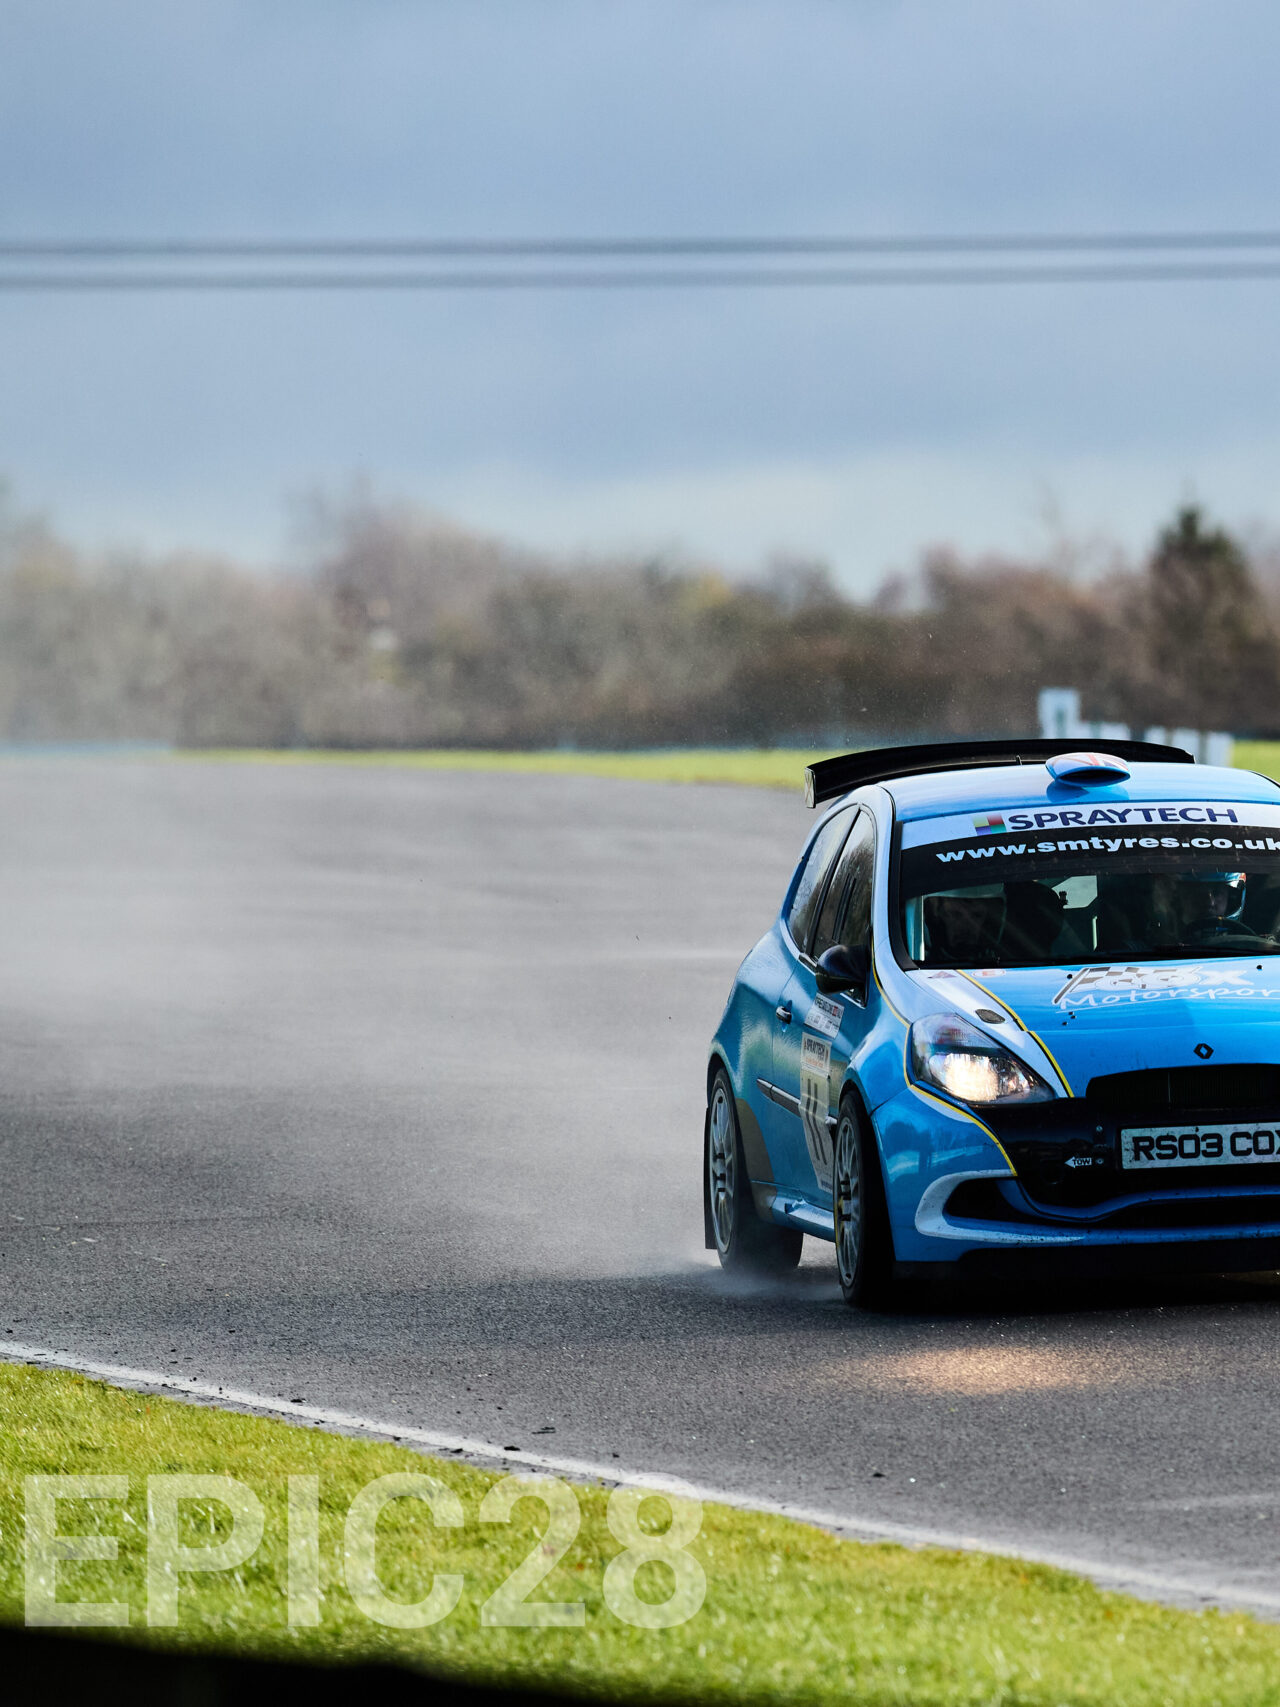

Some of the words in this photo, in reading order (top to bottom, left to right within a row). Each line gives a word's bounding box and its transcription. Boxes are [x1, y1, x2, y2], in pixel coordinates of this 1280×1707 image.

[1008, 807, 1238, 831] SPRAYTECH
[1133, 1132, 1222, 1160] RS03
[1072, 1157, 1092, 1167] TOW
